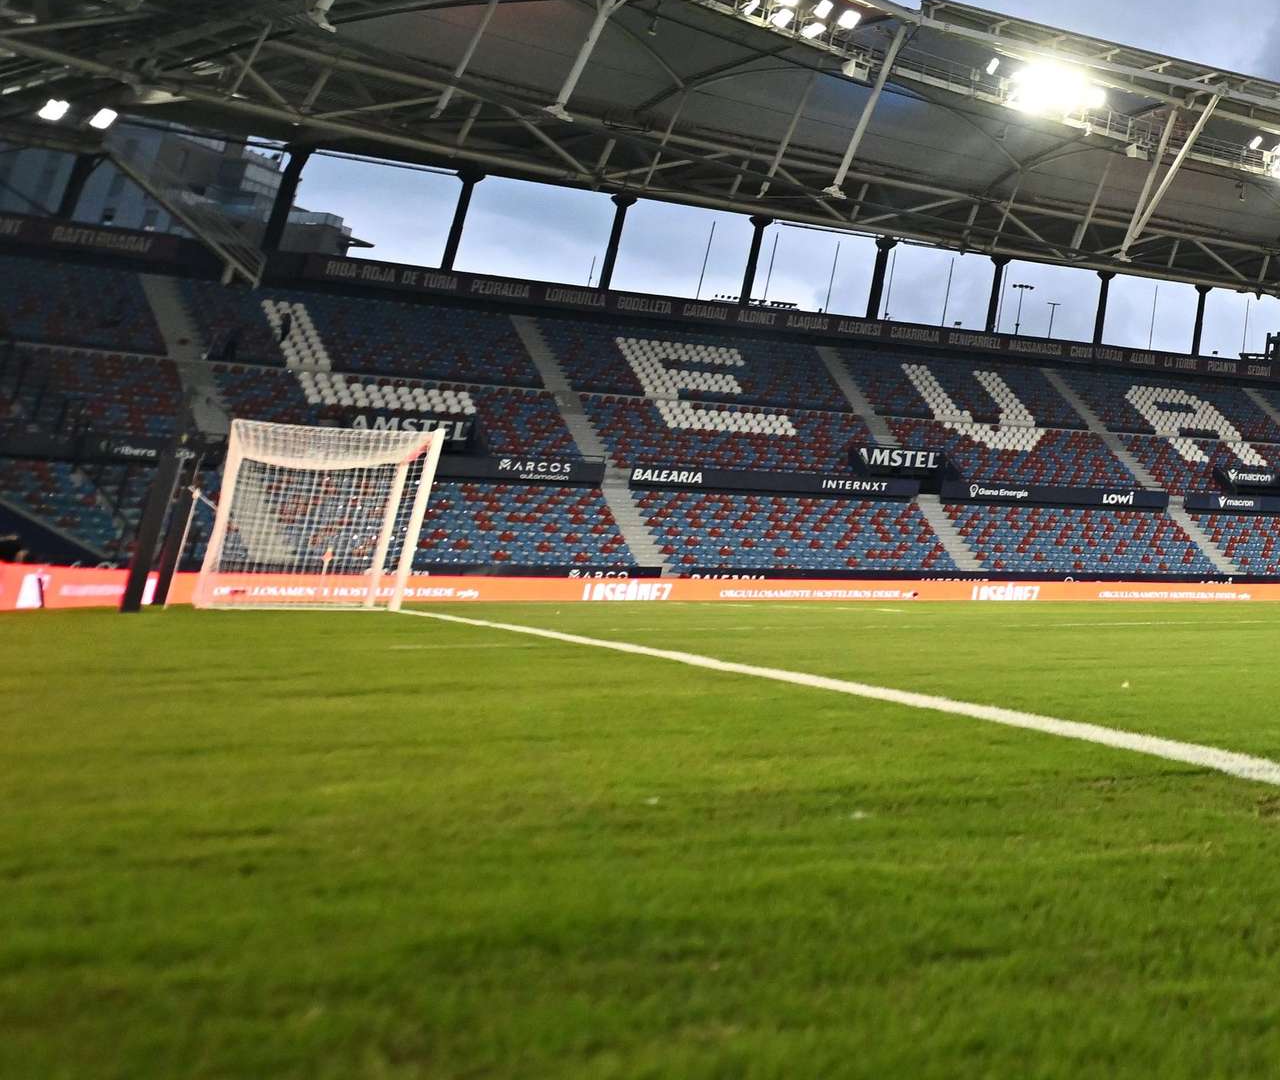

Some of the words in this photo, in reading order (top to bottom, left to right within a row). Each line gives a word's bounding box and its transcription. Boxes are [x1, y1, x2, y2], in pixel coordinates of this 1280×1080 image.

[1237, 472, 1273, 483] macron
[821, 479, 889, 492] INTERNXT
[1226, 497, 1255, 508] macron
